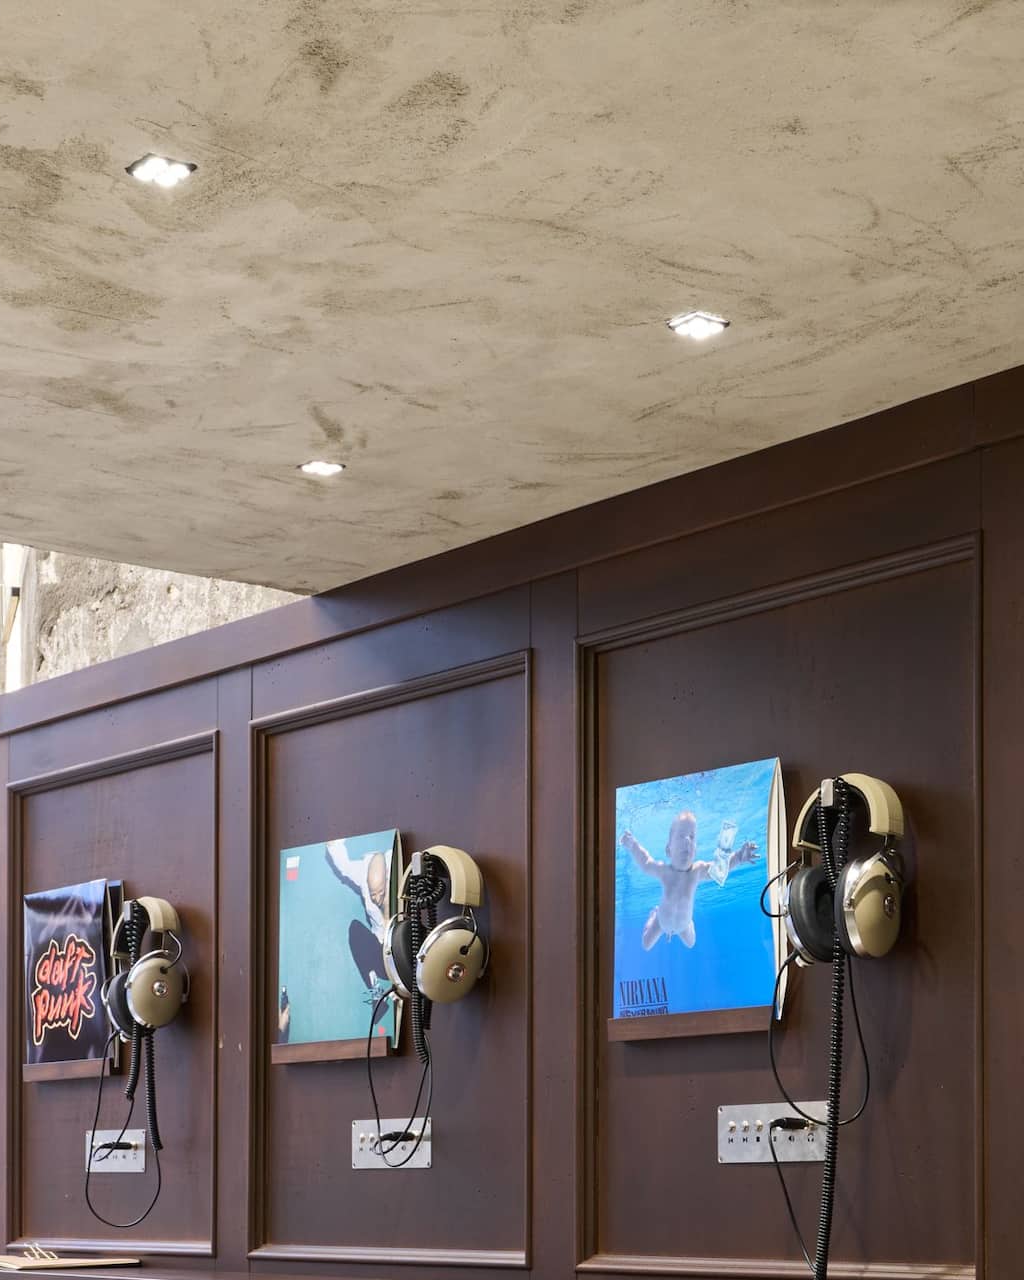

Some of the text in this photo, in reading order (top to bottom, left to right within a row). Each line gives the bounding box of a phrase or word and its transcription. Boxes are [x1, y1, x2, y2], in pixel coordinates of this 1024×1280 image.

[37, 940, 94, 990] daft
[33, 970, 92, 1038] punk
[619, 976, 668, 1006] NIRVANA
